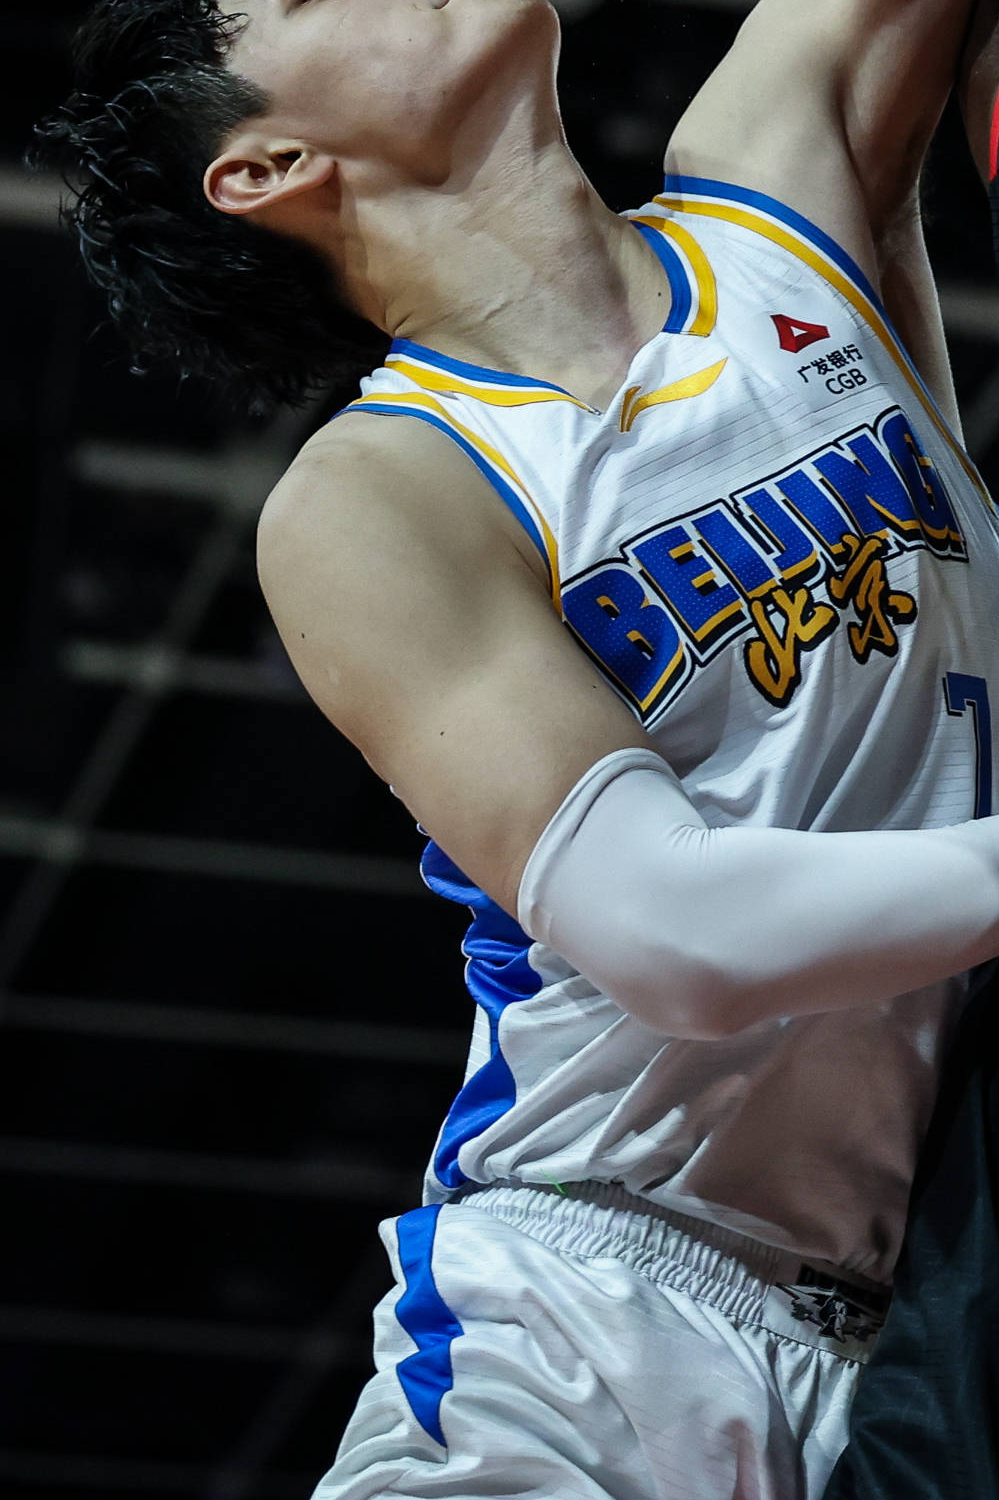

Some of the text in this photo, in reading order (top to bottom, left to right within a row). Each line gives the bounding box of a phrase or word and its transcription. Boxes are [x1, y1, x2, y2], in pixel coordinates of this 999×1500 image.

[797, 343, 863, 383] 广发银行
[825, 368, 868, 395] CGB
[561, 406, 967, 727] BEIJING
[744, 532, 918, 709] 北京
[943, 671, 994, 821] 7
